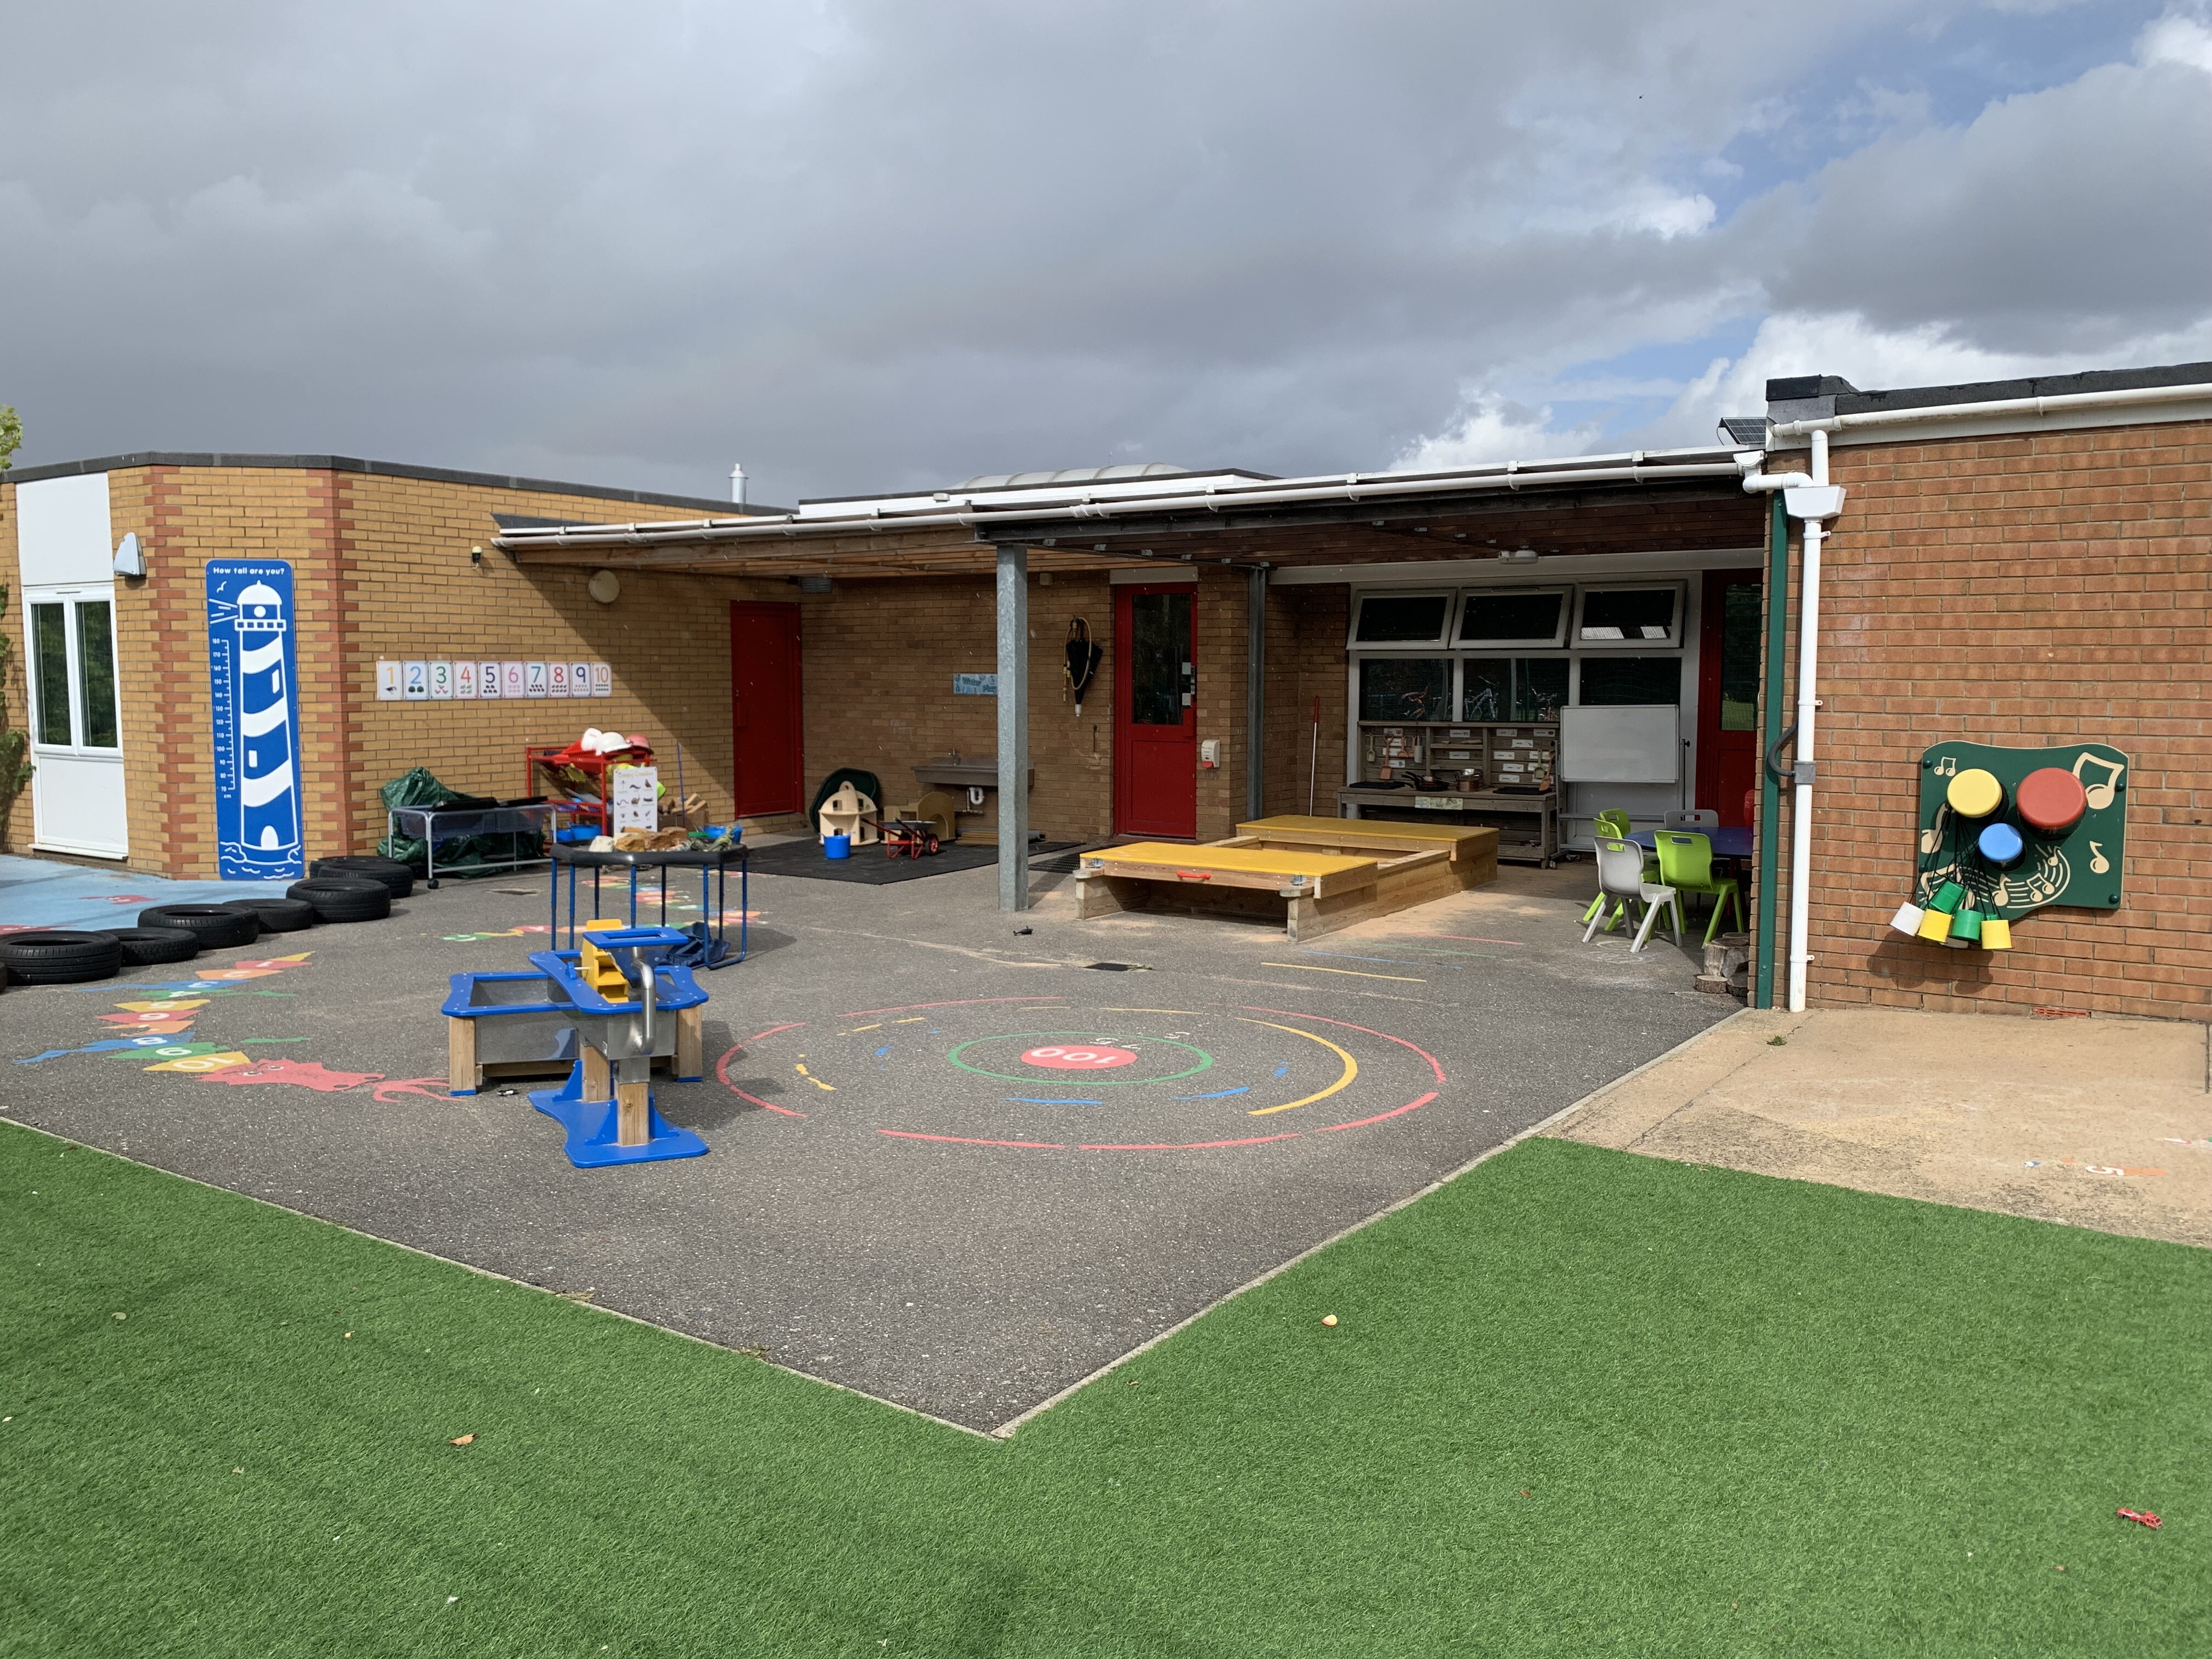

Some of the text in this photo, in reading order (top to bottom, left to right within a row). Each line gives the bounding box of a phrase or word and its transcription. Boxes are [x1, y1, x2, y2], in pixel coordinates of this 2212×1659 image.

[266, 568, 285, 576] you?
[386, 666, 608, 684] 1 2 3 4 5 6 7 8 9 10
[1030, 1048, 1119, 1064] 100
